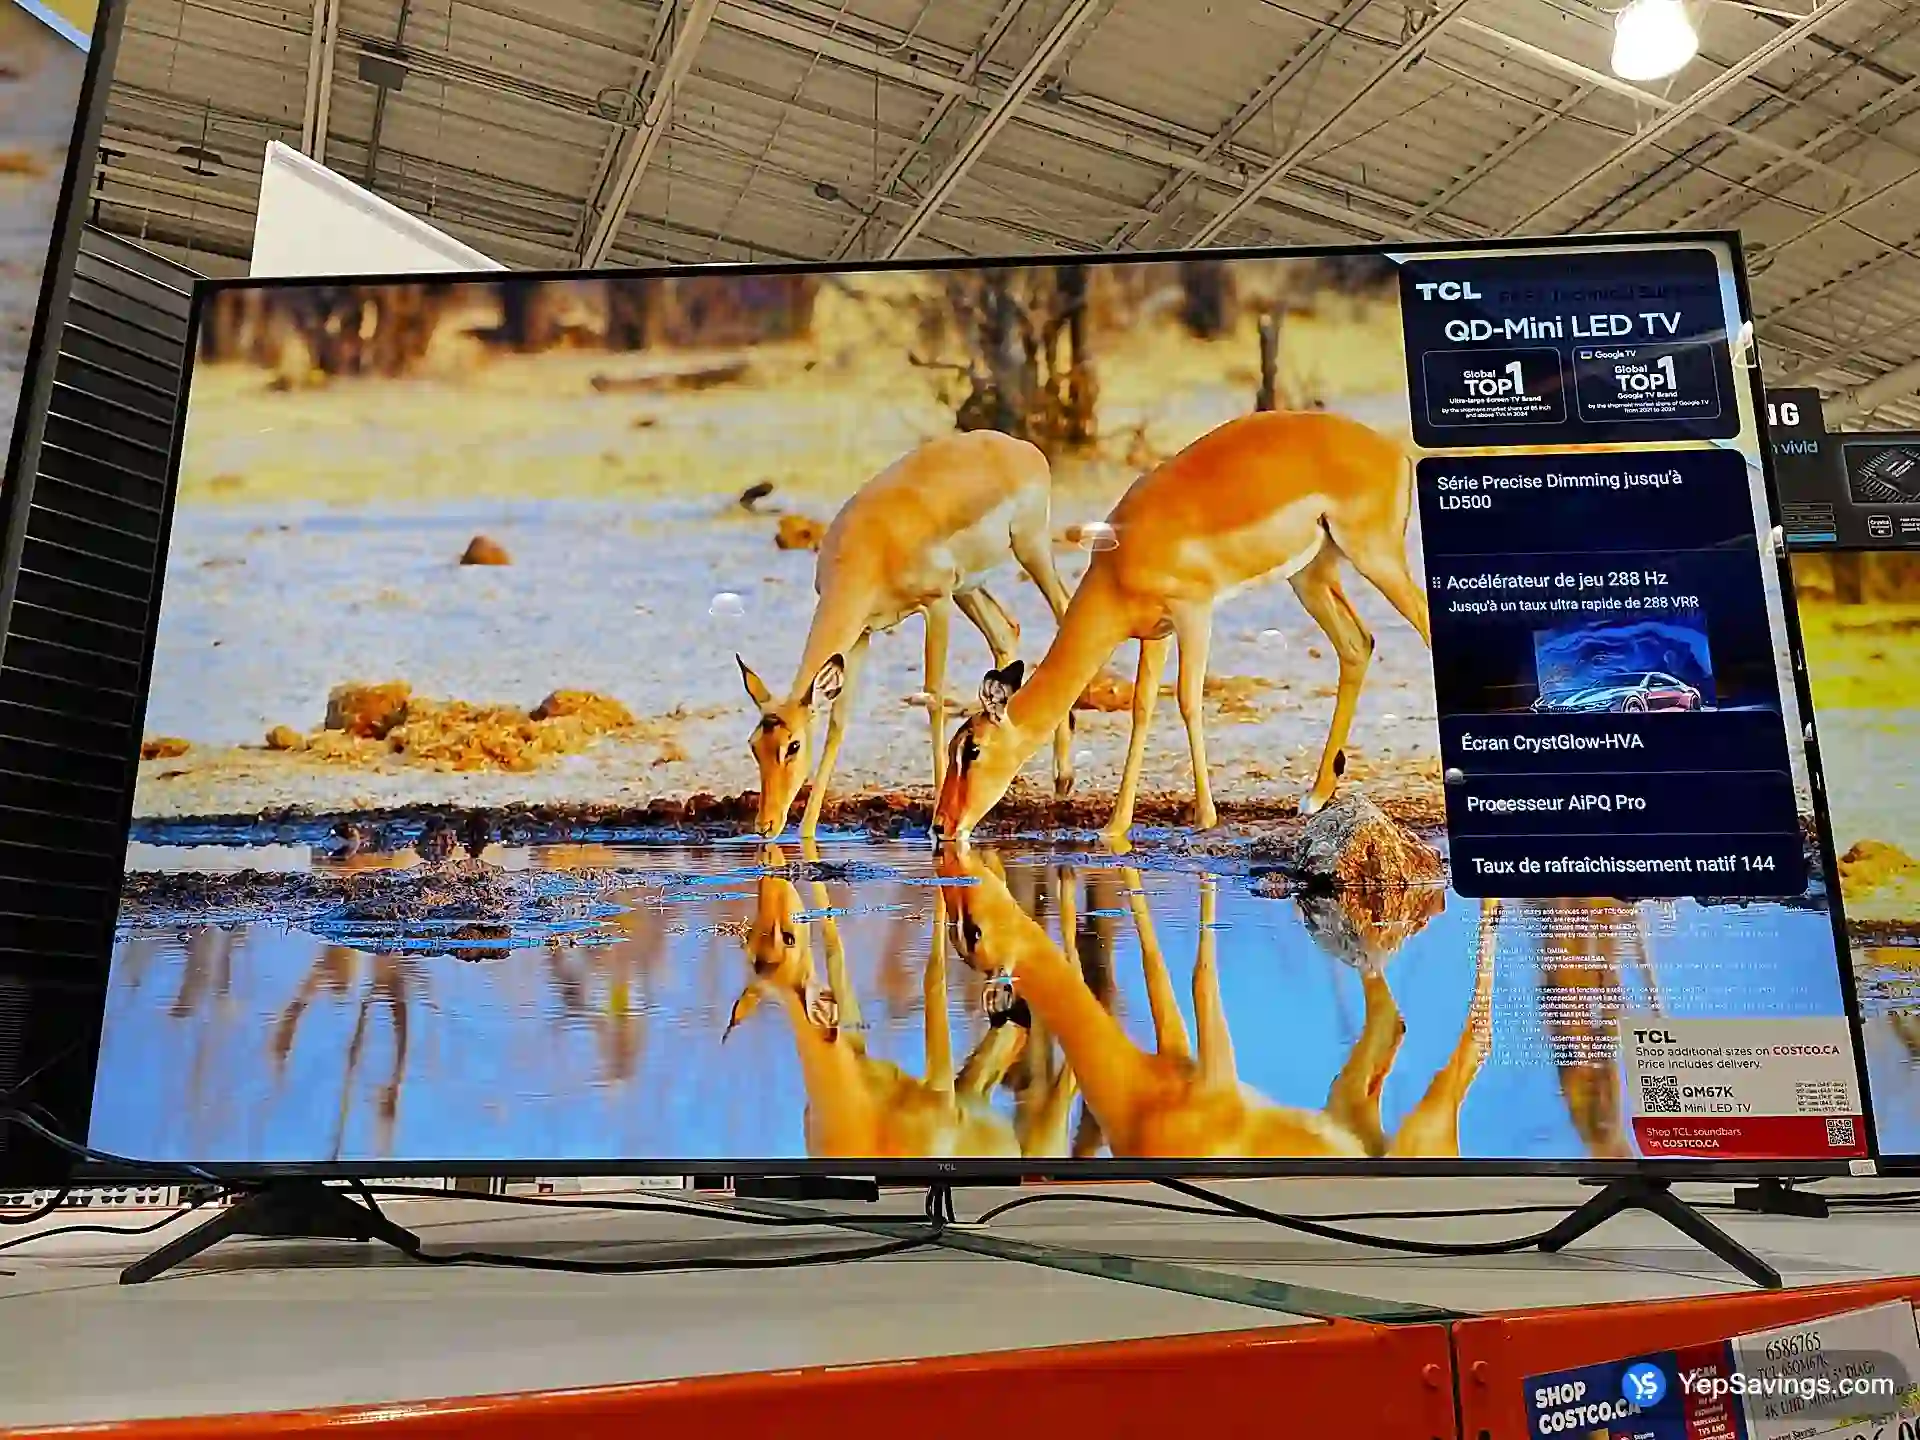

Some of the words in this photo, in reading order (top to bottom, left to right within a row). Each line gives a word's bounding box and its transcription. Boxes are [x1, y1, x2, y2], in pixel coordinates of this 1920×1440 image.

[1416, 281, 1482, 300] TCL
[1445, 316, 1563, 342] QD-Mini
[1572, 314, 1633, 338] LED
[1640, 312, 1682, 335] TV
[1595, 351, 1624, 360] Google
[1463, 369, 1496, 379] Global
[1615, 364, 1648, 374] Global
[1617, 392, 1643, 400] Google
[1781, 440, 1818, 454] vivid
[1437, 475, 1478, 490] Série
[1483, 475, 1542, 489] Precise
[1547, 473, 1620, 490] Dimming
[1623, 469, 1683, 490] jusqu'à
[1439, 495, 1492, 510] LD500
[1447, 572, 1550, 590] Accélérateur
[1555, 573, 1575, 588] de
[1578, 572, 1604, 591] jeu
[1608, 571, 1641, 587] 288
[1644, 571, 1669, 586] Hz
[1448, 600, 1498, 615] Jusqu'à
[1500, 602, 1517, 612] un
[1519, 600, 1547, 611] taux
[1550, 598, 1579, 610] ultra
[1581, 596, 1622, 612] rapide
[1624, 596, 1641, 609] de
[1643, 596, 1668, 609] 288
[1670, 595, 1699, 609] VRR
[1461, 731, 1509, 751] Écran
[1513, 732, 1645, 753] CrystGlow-HVA
[1467, 796, 1563, 812] Processeur
[1568, 795, 1612, 812] AiPQ
[1616, 794, 1647, 810] Pro
[1472, 858, 1515, 874] Taux
[1519, 857, 1541, 873] de
[1545, 855, 1692, 874] rafraîchissement
[1696, 855, 1736, 872] natif
[1741, 856, 1775, 872] 144
[1633, 1030, 1676, 1043] TCL
[1636, 1047, 1664, 1056] Shop
[1667, 1046, 1722, 1056] additional
[1725, 1047, 1752, 1056] sizes
[1756, 1047, 1770, 1056] on
[1773, 1045, 1840, 1056] COSTCO.CA
[1637, 1059, 1664, 1069] Price
[1669, 1059, 1713, 1069] includes
[1716, 1059, 1762, 1070] delivery.
[1682, 1086, 1734, 1098] QM67K
[1684, 1103, 1706, 1112] Mini
[1710, 1103, 1732, 1112] LED
[1737, 1103, 1751, 1112] TV
[1646, 1127, 1670, 1137] Shop
[1673, 1127, 1692, 1136] TCL
[1693, 1127, 1741, 1136] soundbars
[1662, 1139, 1719, 1148] COSTCO.CA
[937, 1163, 957, 1171] TCL
[1765, 1332, 1821, 1361] 6586765
[1535, 1380, 1586, 1409] SHOP
